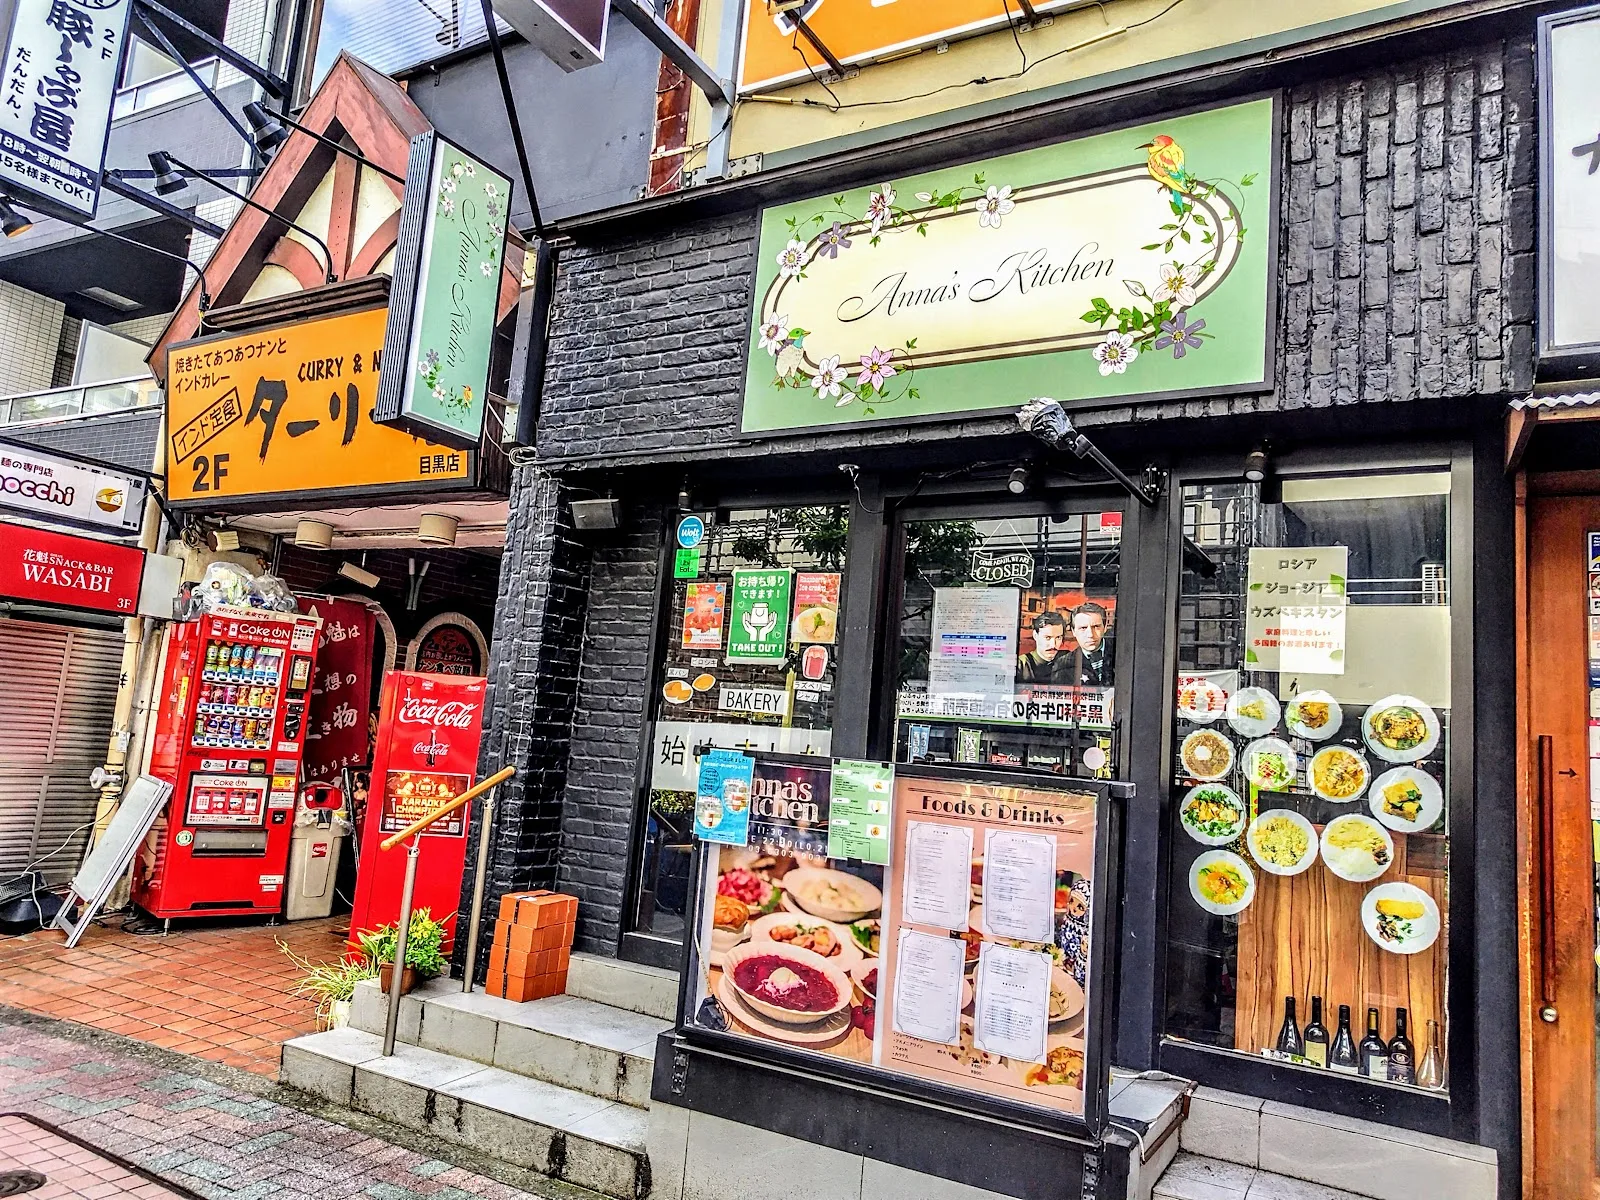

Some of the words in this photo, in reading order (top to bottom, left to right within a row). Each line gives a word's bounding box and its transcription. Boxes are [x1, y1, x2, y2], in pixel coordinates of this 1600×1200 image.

[837, 271, 961, 323] Anna's
[968, 241, 1114, 303] Kitchen
[446, 282, 473, 368] Kitchen
[175, 338, 287, 374] 焼きたてあつあつナンと
[297, 355, 344, 383] CURRY
[353, 353, 363, 374] &
[175, 373, 231, 395] インドカレー
[177, 398, 239, 453] インド定食
[244, 375, 378, 466] ターリ
[192, 453, 230, 492] 2F
[419, 453, 460, 475] 目黒店
[681, 528, 700, 537] Wolt
[23, 549, 48, 564] 花魁
[1278, 557, 1318, 570] ロシア
[22, 563, 113, 594] WASABI
[738, 575, 785, 588] お持ち帰り
[976, 563, 1029, 581] CLOSED
[1265, 581, 1330, 595] ジョージア
[117, 598, 132, 609] 3F
[1250, 605, 1343, 619] ウズベキスタン
[239, 624, 270, 636] Coke
[324, 621, 361, 648] 魁は
[1265, 627, 1331, 637] 家庭料理と珍しい
[732, 643, 755, 653] TAKE
[726, 691, 781, 712] BAKERY
[213, 778, 234, 787] Coke
[752, 777, 813, 802] nna's
[749, 795, 819, 824] tchen
[922, 795, 976, 817] Foods
[981, 803, 993, 818] &
[998, 804, 1066, 826] Drinks
